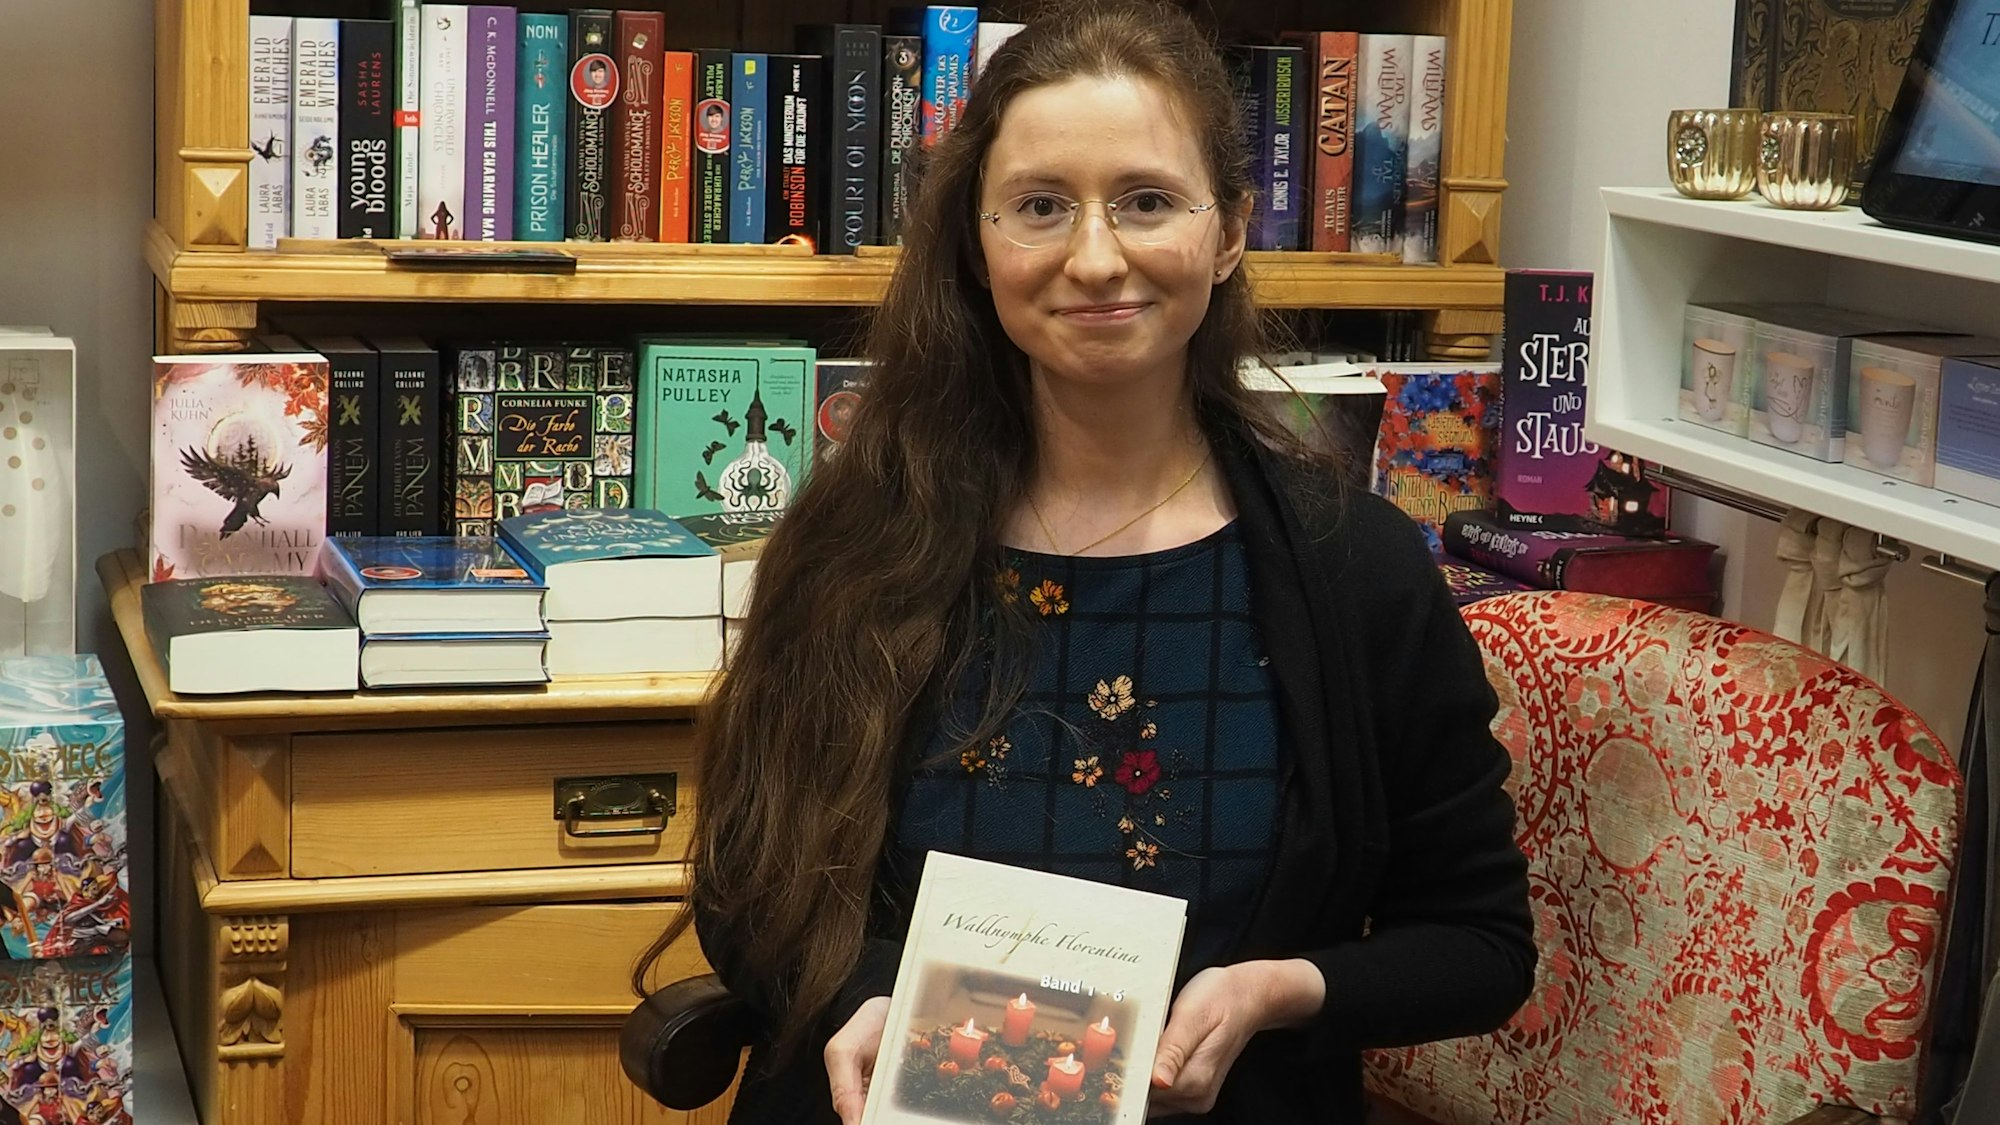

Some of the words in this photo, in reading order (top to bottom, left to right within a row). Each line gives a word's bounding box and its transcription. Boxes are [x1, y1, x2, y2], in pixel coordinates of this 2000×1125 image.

[486, 31, 496, 42] K.
[487, 16, 497, 29] C.
[526, 25, 558, 39] NONI
[952, 17, 958, 28] 2
[254, 37, 271, 105] EMERALD
[271, 37, 289, 105] WITCHES
[899, 50, 908, 63] 3
[937, 55, 946, 71] DES
[300, 40, 317, 108] EMERALD
[317, 40, 336, 108] WITCHES
[358, 60, 368, 106] SASHA
[371, 52, 382, 115] LAURENS
[485, 45, 496, 114] McDONNELL
[706, 65, 715, 97] PULLEY
[715, 63, 723, 100] NATASHA
[1276, 56, 1292, 126] AUSSERIRDISCH
[1376, 48, 1397, 130] WILLIAMS
[1395, 75, 1405, 104] TAD
[1421, 49, 1441, 132] WILLIAMS
[406, 90, 416, 104] Die
[847, 70, 867, 132] MOON
[891, 75, 905, 149] DUNKELDORN-
[935, 75, 946, 124] KLOSTER
[1319, 55, 1350, 157] CATAN
[432, 81, 444, 152] CHRONICLES
[445, 78, 456, 156] UNDERWORLD
[667, 98, 683, 140] JACKSON
[739, 107, 755, 149] JACKSON
[783, 95, 795, 146] MINISTERIUM
[796, 97, 807, 133] ZUKUNFT
[902, 88, 914, 149] CHRONIKEN
[483, 121, 497, 148] THIS
[531, 103, 550, 168] HEALER
[580, 107, 601, 192] SCHOLOMANCE
[626, 110, 646, 193] SCHOLOMANCE
[796, 134, 806, 147] DIE
[1274, 133, 1290, 166] TAYLOR
[404, 152, 414, 179] Lunde
[665, 142, 683, 180] PERCY
[737, 152, 756, 191] PERCY
[783, 147, 794, 164] DAS
[795, 148, 806, 165] FÜR
[891, 149, 901, 164] DIE
[1383, 158, 1393, 183] TAL
[351, 139, 370, 210] young
[366, 139, 387, 214] bloods
[482, 151, 496, 214] CHARMING
[1274, 169, 1289, 178] E.
[259, 183, 270, 214] LAURA
[271, 184, 283, 214] LABAS
[305, 186, 316, 217] LAURA
[317, 187, 329, 217] LABAS
[404, 186, 414, 207] Maja
[530, 173, 548, 232] PRISON
[704, 171, 713, 211] FILIGREE
[713, 176, 721, 230] UHRMACHER
[789, 167, 805, 226] ROBINSON
[1273, 181, 1288, 211] DENNIS
[844, 177, 864, 246] COURT
[1324, 189, 1336, 229] KLAUS
[1335, 186, 1346, 234] TEUBER
[482, 217, 494, 241] MA
[334, 371, 365, 379] SUZANNE
[335, 380, 364, 389] COLLINS
[394, 371, 426, 379] SUZANNE
[396, 380, 424, 389] COLLINS
[663, 368, 742, 384] NATASHA
[169, 399, 204, 410] JULIA
[502, 399, 552, 408] CORNELIA
[554, 399, 588, 408] FUNKE
[663, 388, 731, 403] PULLEY
[1553, 392, 1582, 414] UND
[170, 410, 208, 421] KUHN
[499, 413, 537, 432] Die
[535, 409, 579, 437] Farbe
[516, 433, 536, 453] der
[539, 435, 583, 456] Rache
[345, 438, 370, 517] PANEM
[406, 438, 430, 517] PANEM
[1517, 474, 1543, 484] ROMAN
[1510, 513, 1537, 523] HEYNE
[942, 911, 1058, 955] Waldnymphe
[1054, 930, 1142, 965] Florentina
[1040, 974, 1081, 995] Band
[1088, 986, 1094, 996] 1
[1113, 989, 1124, 1002] 6
